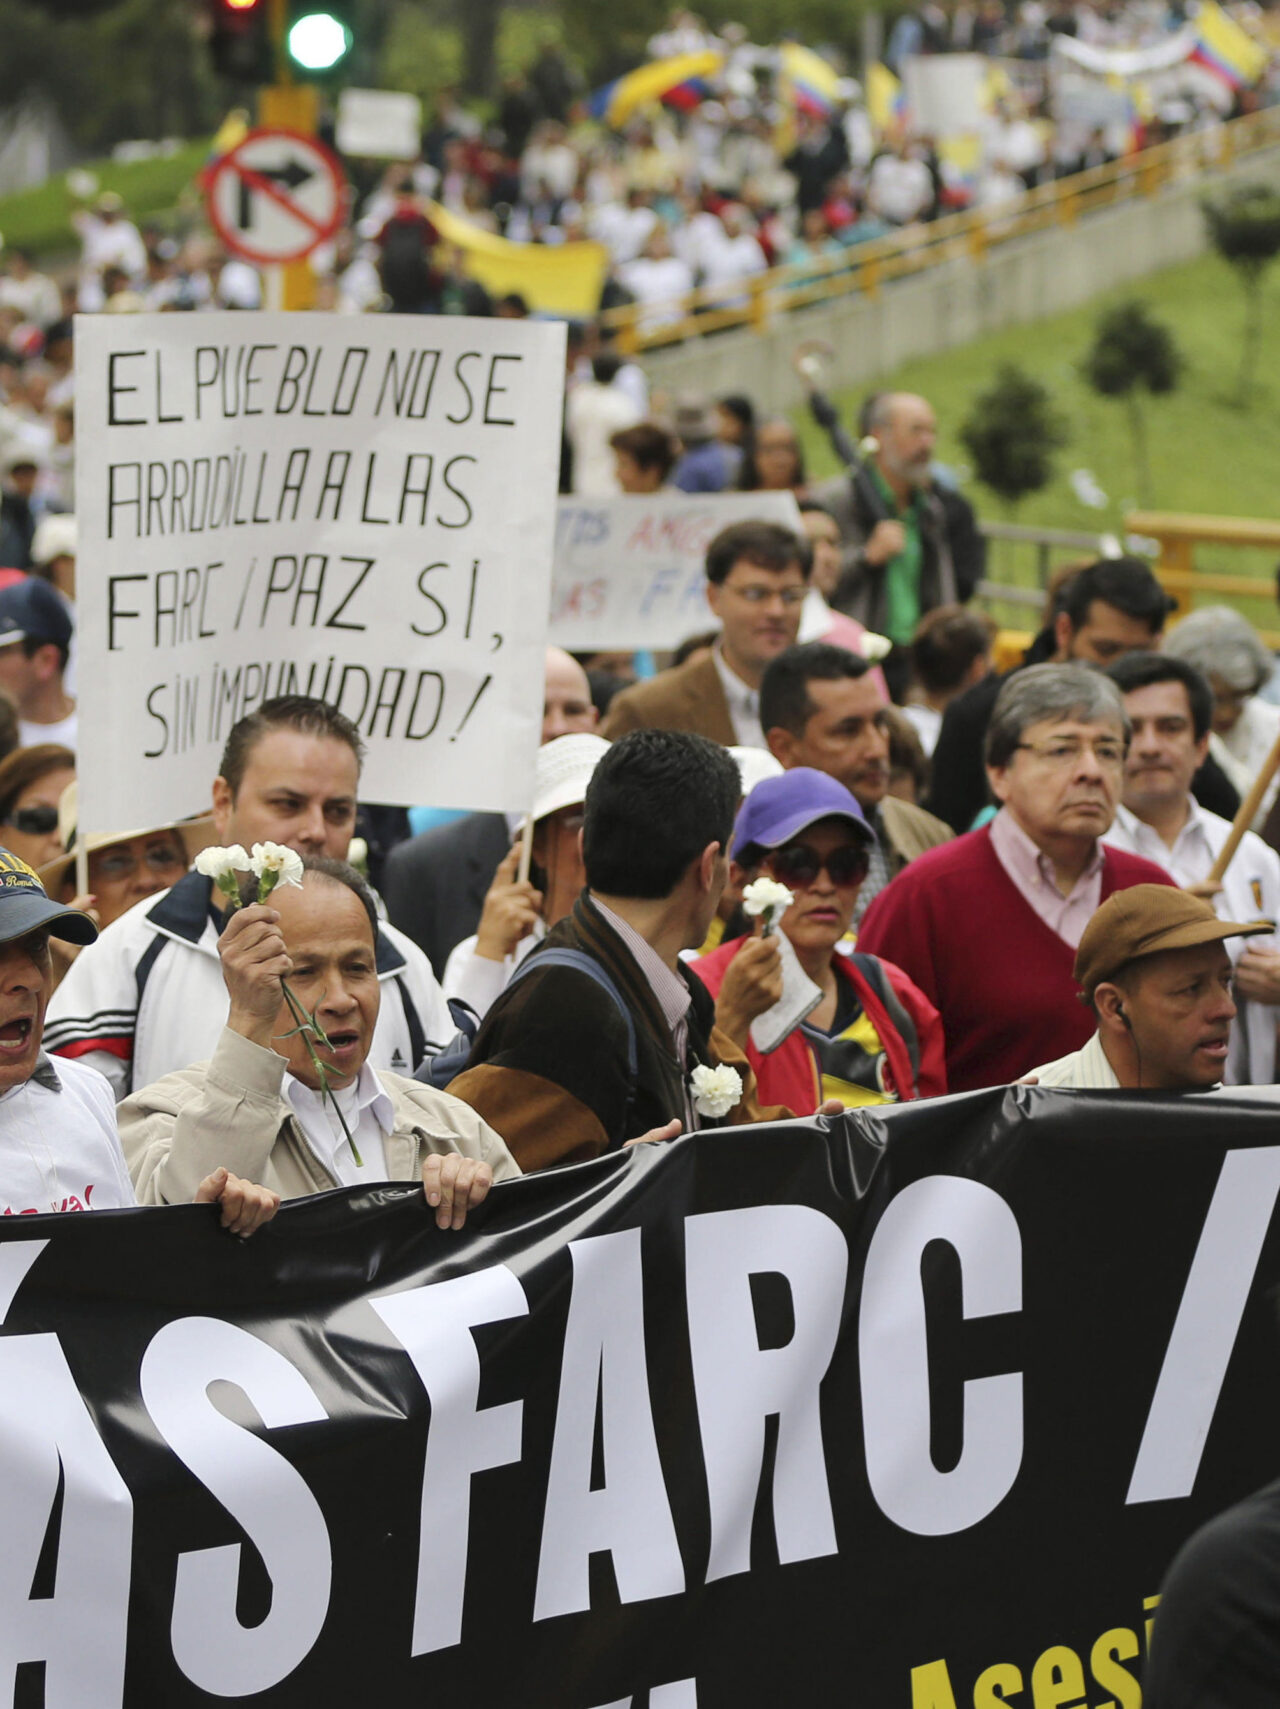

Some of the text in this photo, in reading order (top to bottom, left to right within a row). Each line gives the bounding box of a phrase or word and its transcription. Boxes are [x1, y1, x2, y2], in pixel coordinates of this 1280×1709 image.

[107, 344, 523, 427] EL PUEBLO NO SE
[107, 447, 477, 540] ARRODILLA A LAS
[107, 562, 224, 651] FARC
[261, 553, 376, 632] PAZ
[143, 674, 199, 758] SIN
[369, 1174, 1024, 1658] FARC
